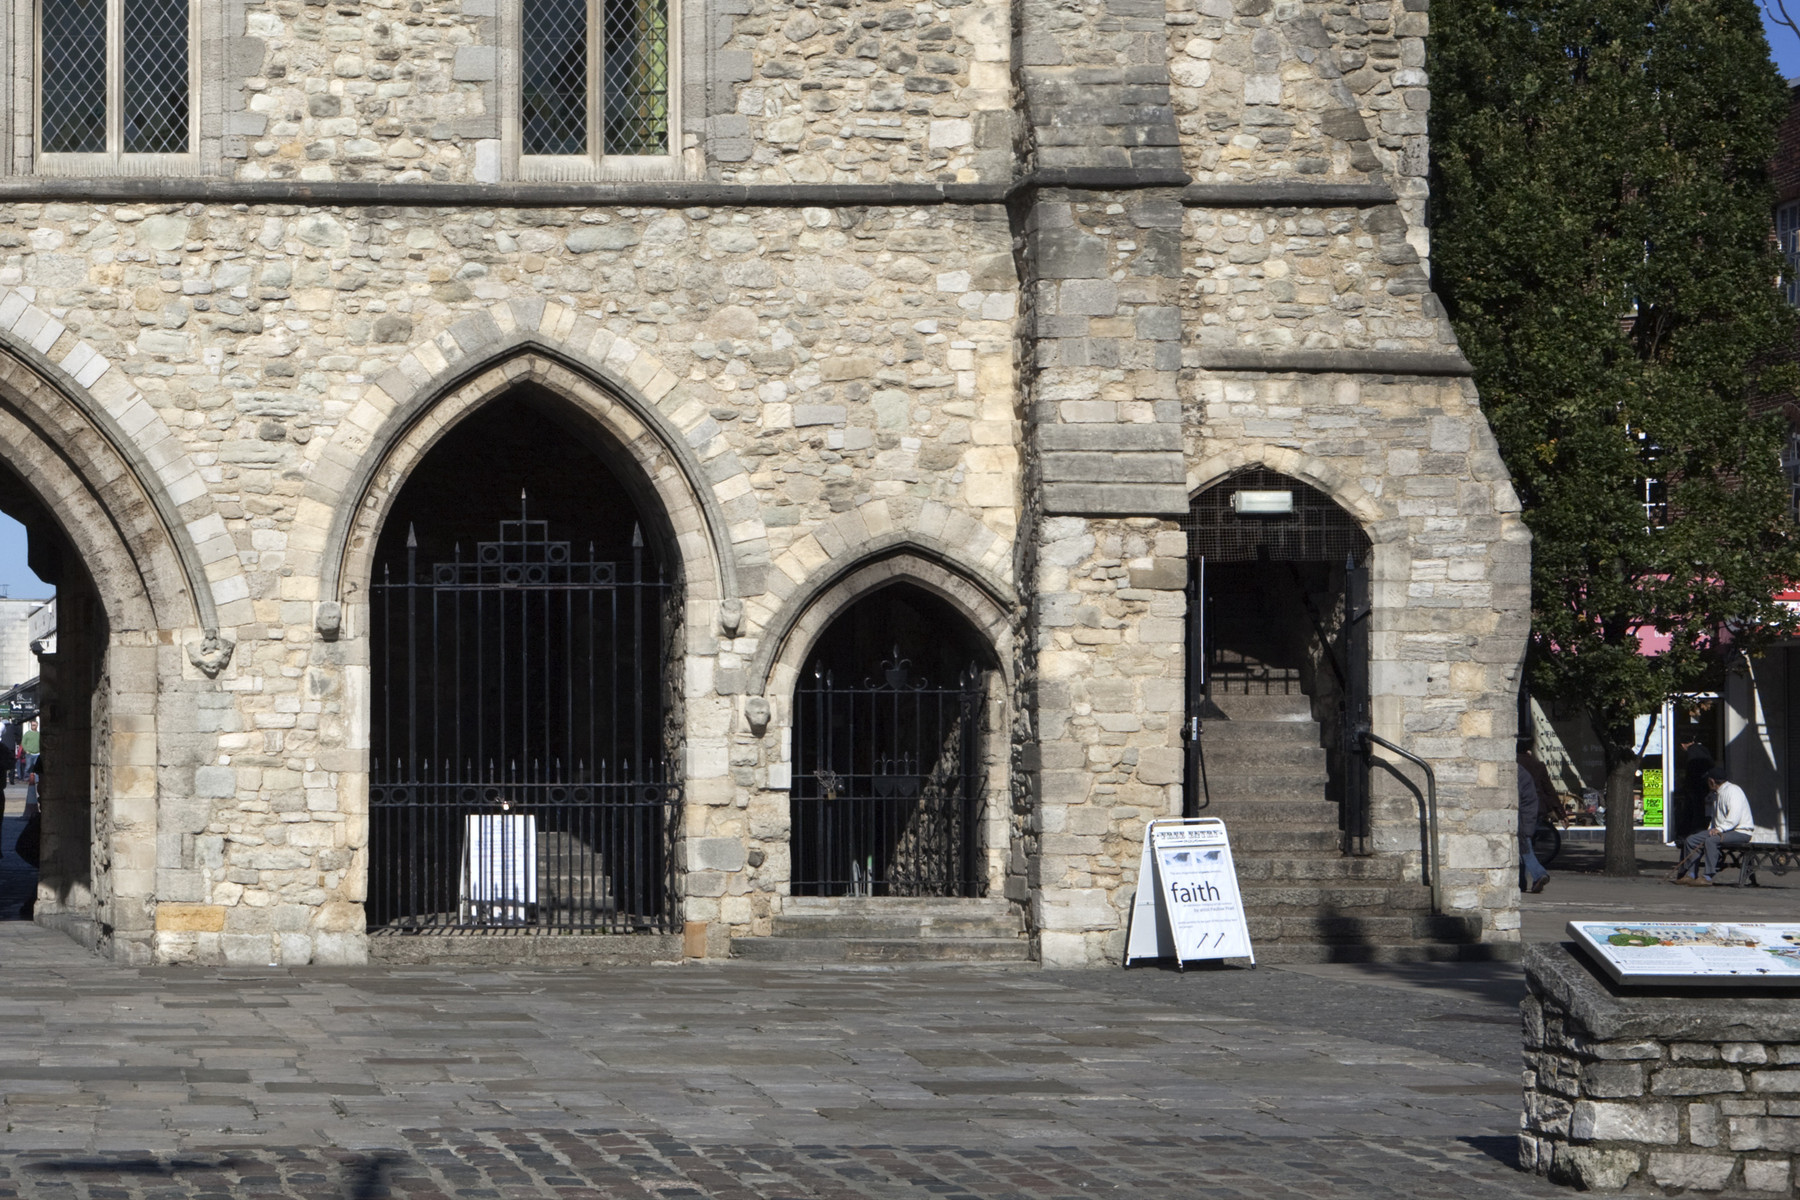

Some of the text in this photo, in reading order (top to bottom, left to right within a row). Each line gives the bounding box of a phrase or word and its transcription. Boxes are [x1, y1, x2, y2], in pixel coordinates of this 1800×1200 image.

[1160, 830, 1219, 840] FREE ENTRY
[1171, 881, 1220, 903] faith
